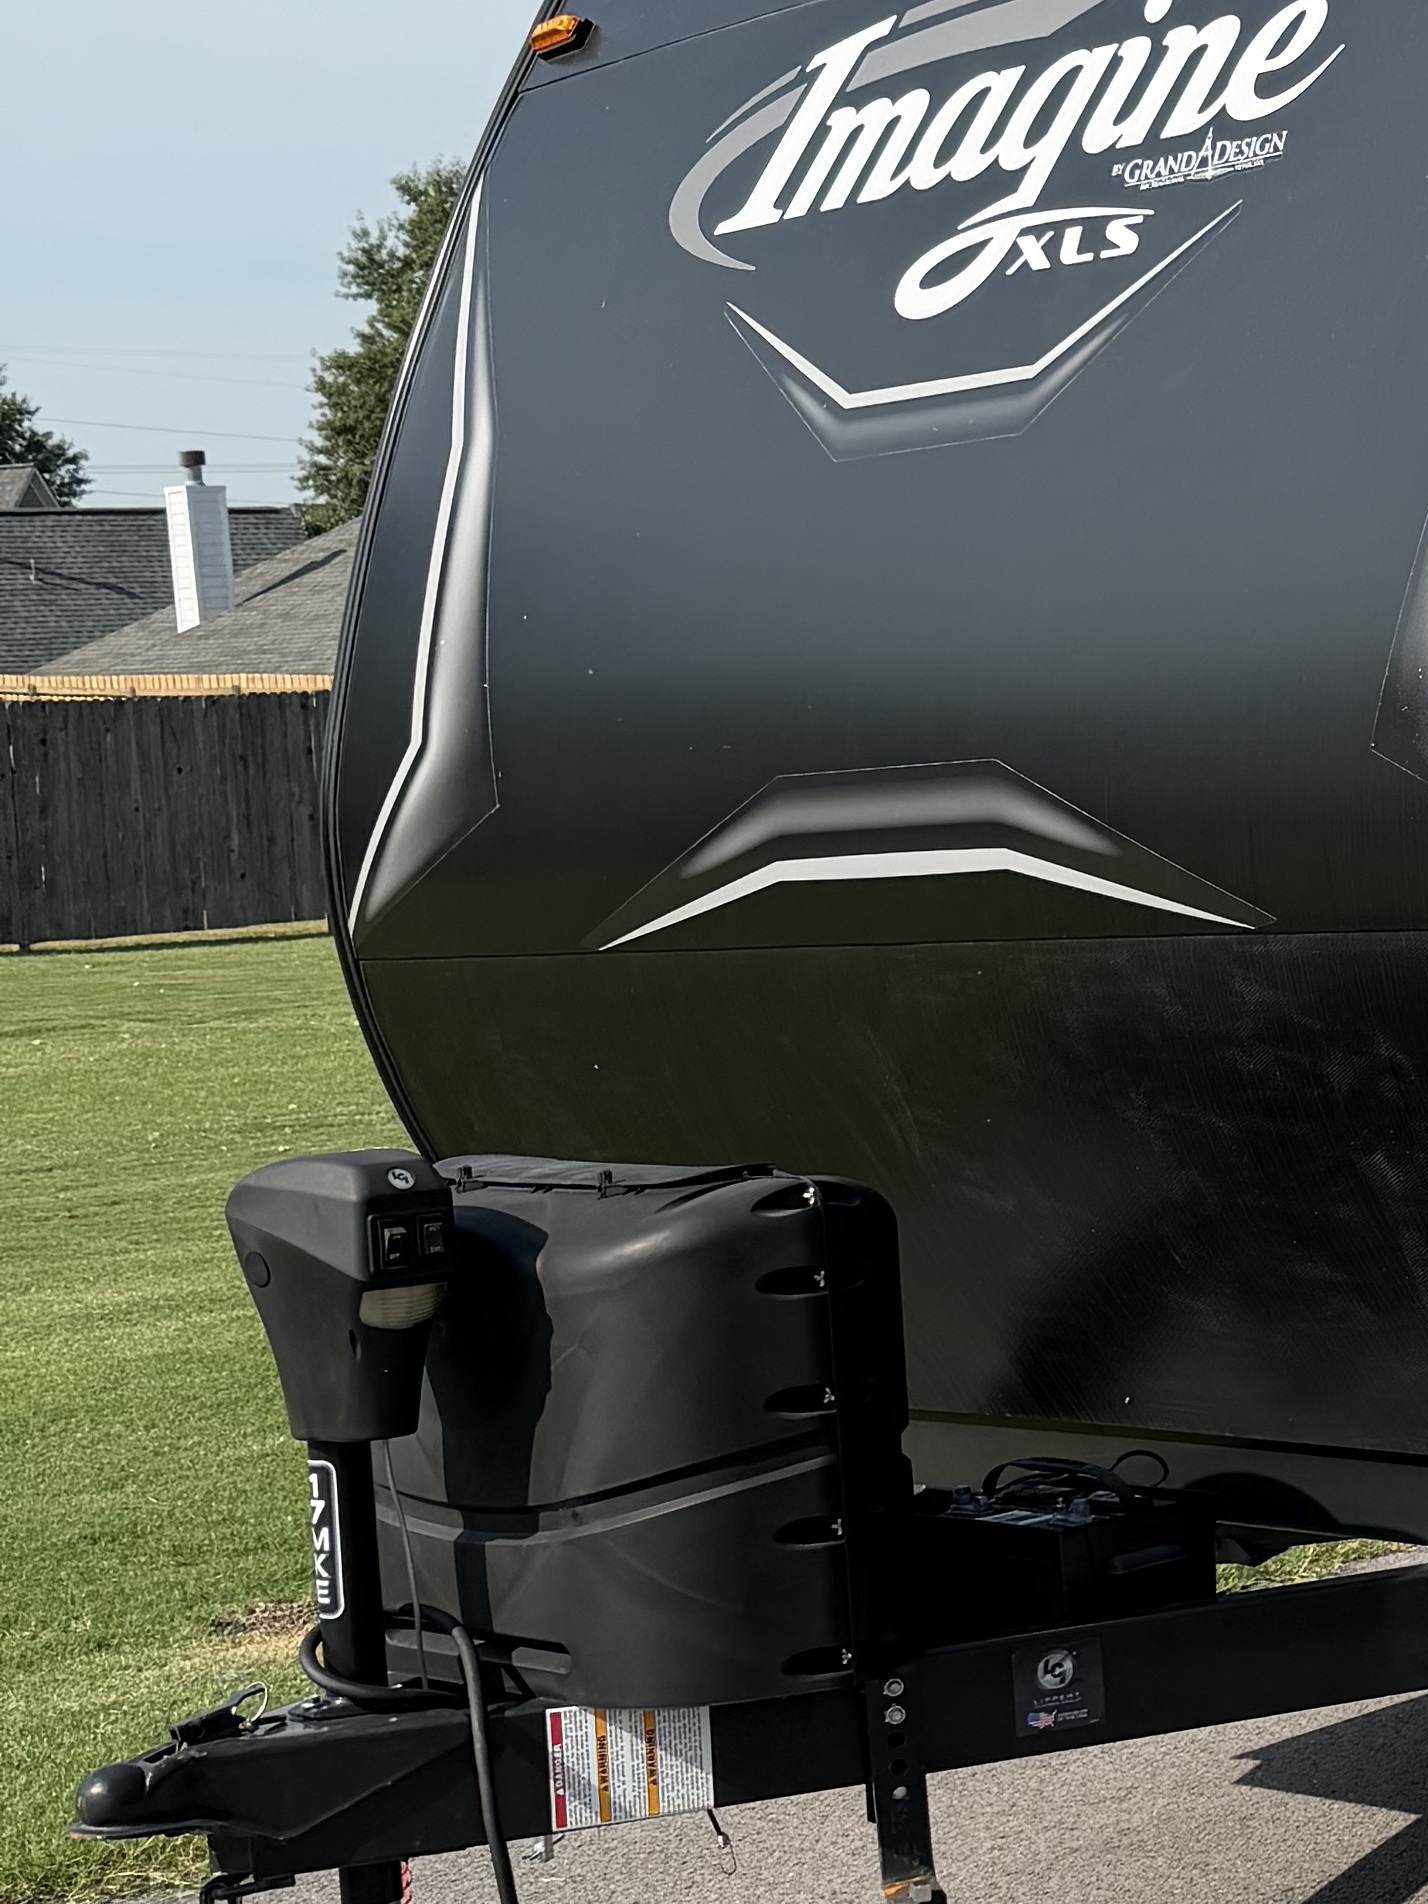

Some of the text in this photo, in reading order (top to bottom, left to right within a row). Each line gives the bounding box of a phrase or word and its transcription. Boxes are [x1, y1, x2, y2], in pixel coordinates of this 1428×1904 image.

[1124, 151, 1196, 183] GRAND
[1213, 130, 1288, 165] DESIGN
[1006, 214, 1143, 276] XLS
[308, 1473, 332, 1604] 17MKE
[553, 1743, 564, 1788] DANGER
[597, 1734, 609, 1783] WARNING
[646, 1729, 657, 1777] WARNING
